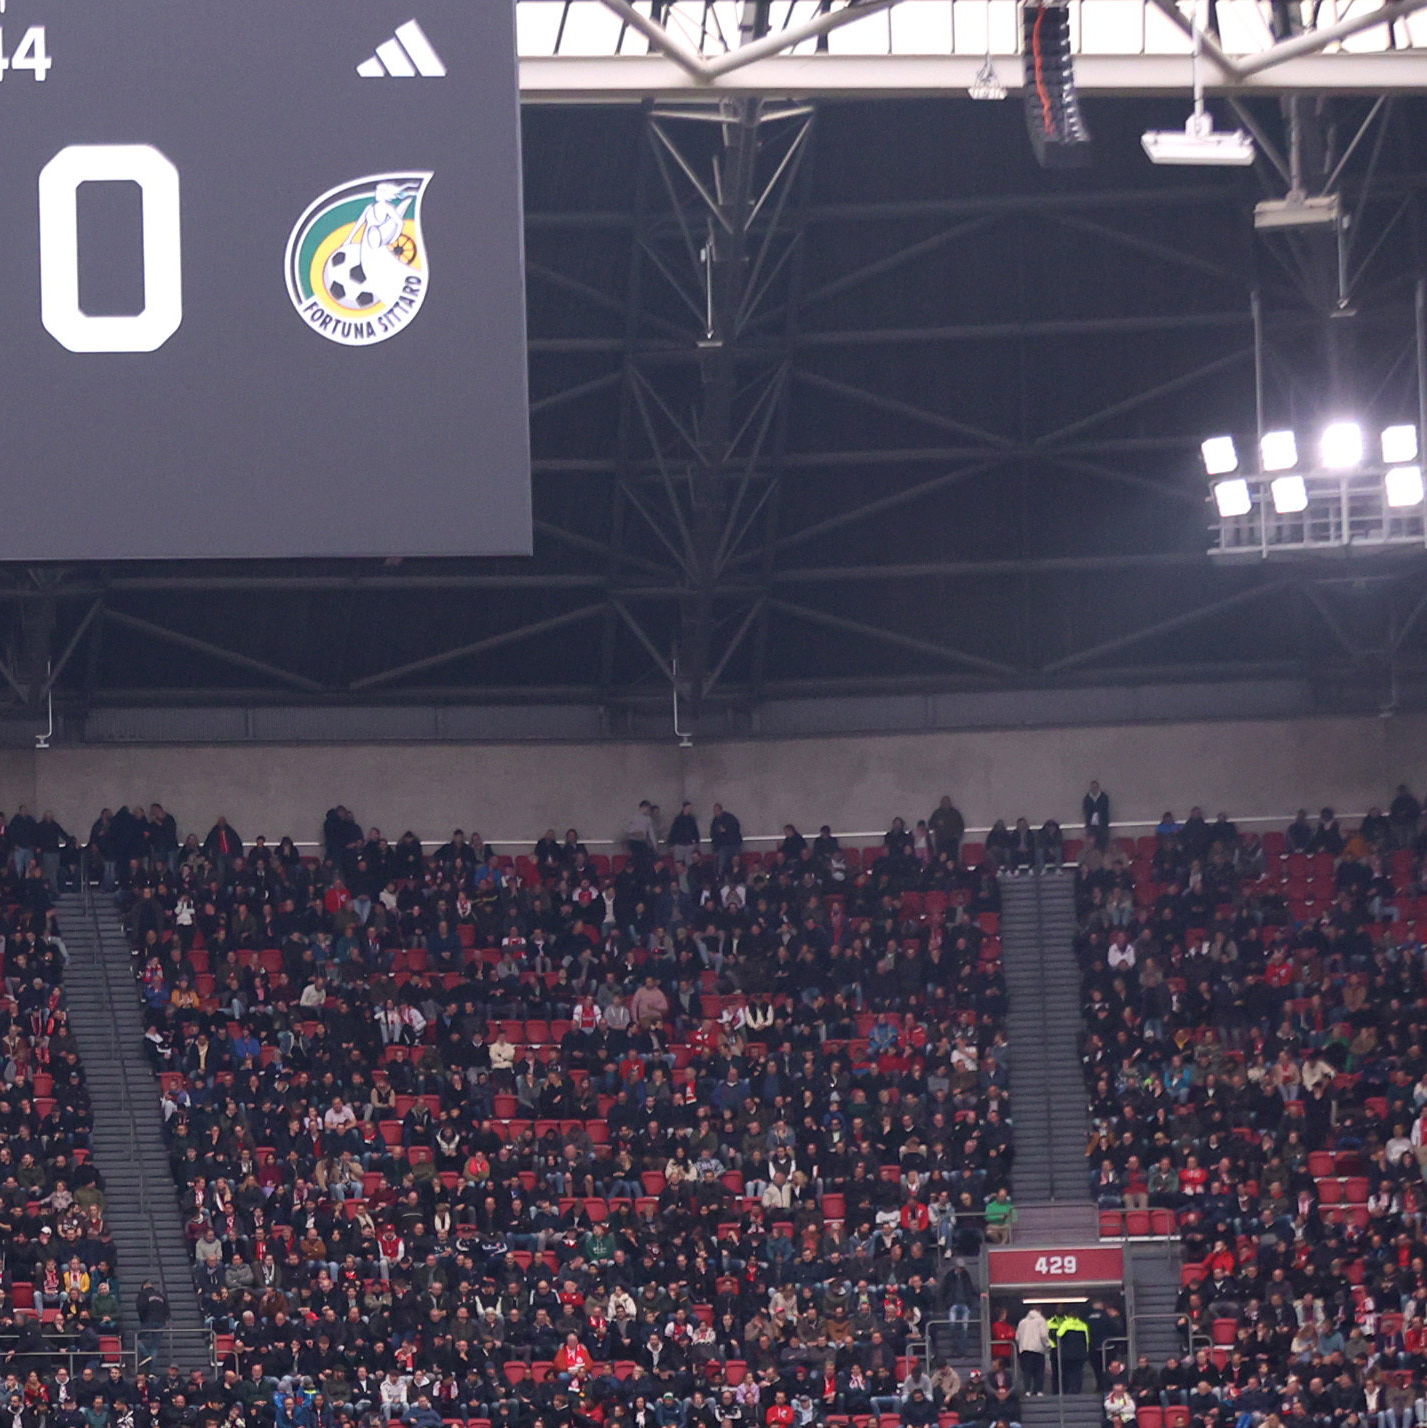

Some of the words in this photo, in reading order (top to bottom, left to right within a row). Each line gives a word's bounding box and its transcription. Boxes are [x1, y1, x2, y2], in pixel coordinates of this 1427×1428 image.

[38, 144, 183, 353] 0
[303, 301, 377, 340] FORTUNA
[377, 275, 423, 333] SITTARD
[1034, 1256, 1077, 1275] 429
